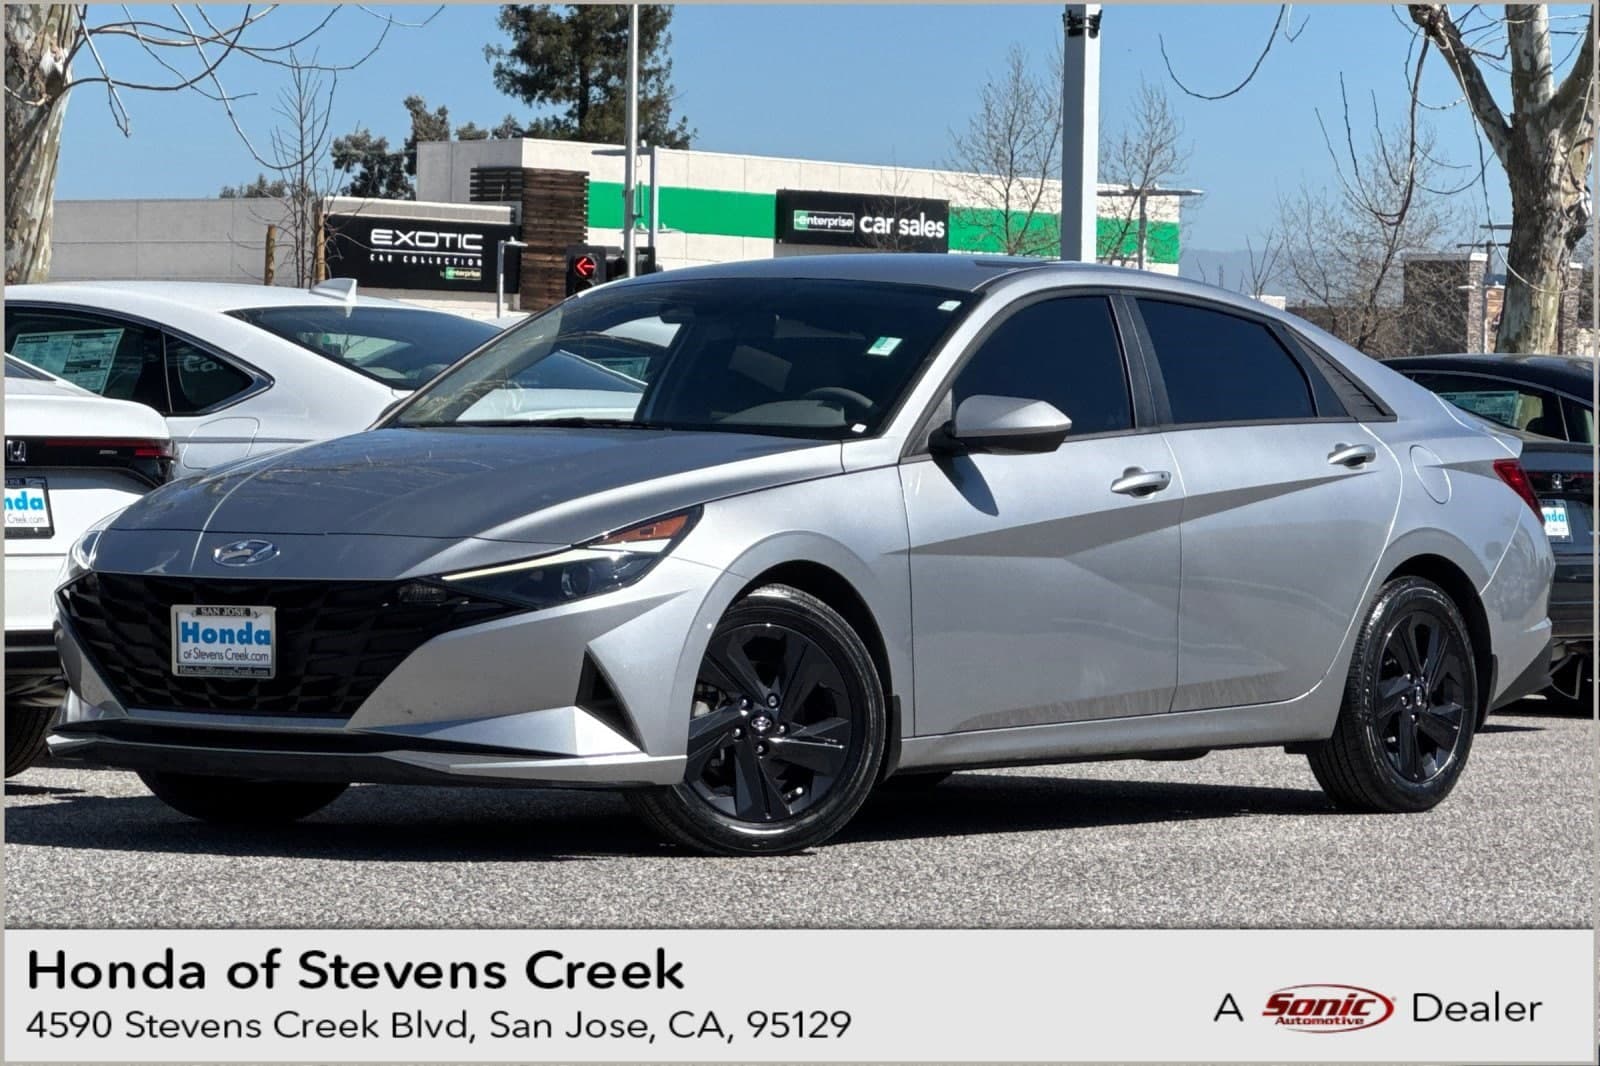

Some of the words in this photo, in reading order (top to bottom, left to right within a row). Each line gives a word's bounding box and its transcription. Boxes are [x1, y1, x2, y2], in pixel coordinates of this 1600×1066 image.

[795, 214, 854, 229] enterprise
[859, 215, 894, 235] car
[898, 212, 945, 238] sales
[370, 228, 483, 250] EXOTIC
[370, 253, 393, 263] CAR
[403, 255, 483, 266] COLLECTION
[201, 607, 220, 616] SAN
[222, 607, 246, 617] JOSE
[181, 621, 271, 646] Honda
[183, 649, 193, 660] of
